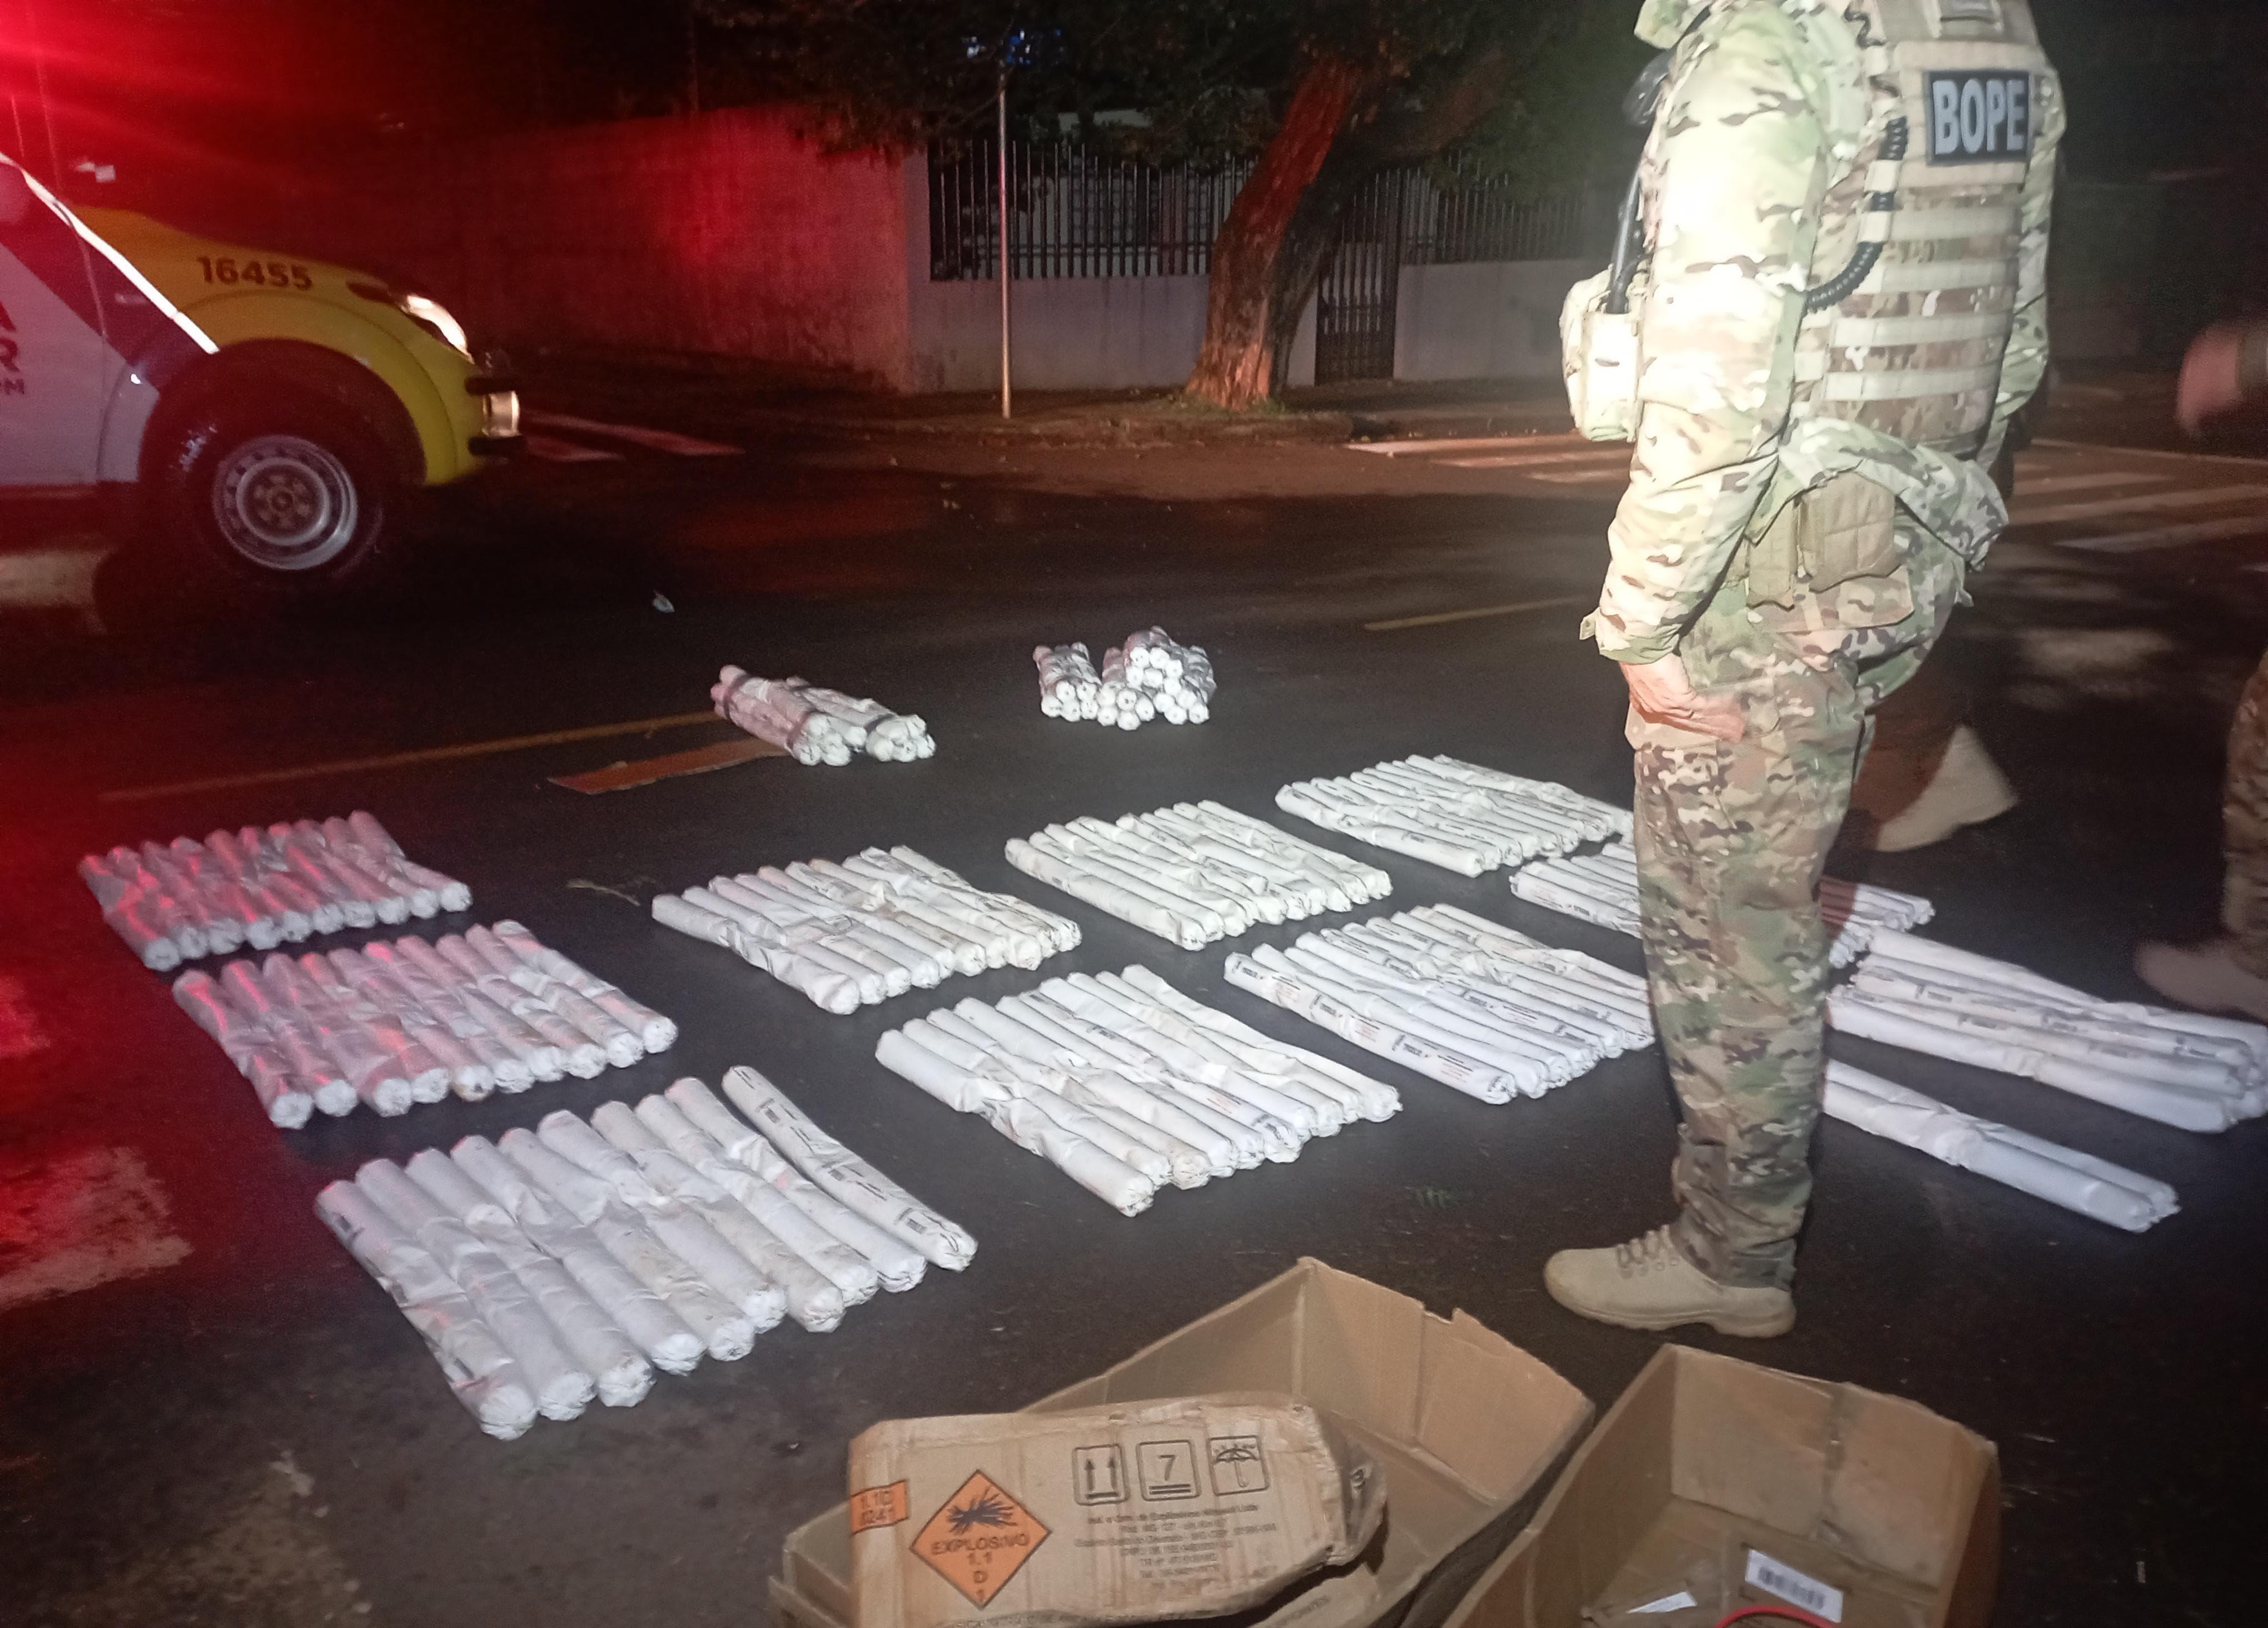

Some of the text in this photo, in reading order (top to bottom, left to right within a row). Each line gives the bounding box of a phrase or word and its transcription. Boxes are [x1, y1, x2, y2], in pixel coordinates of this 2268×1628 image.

[1932, 78, 2025, 155] BOPE
[196, 256, 313, 290] 16455
[1158, 1454, 1177, 1482] 7
[932, 1533, 1029, 1555] EXPLOSIVO
